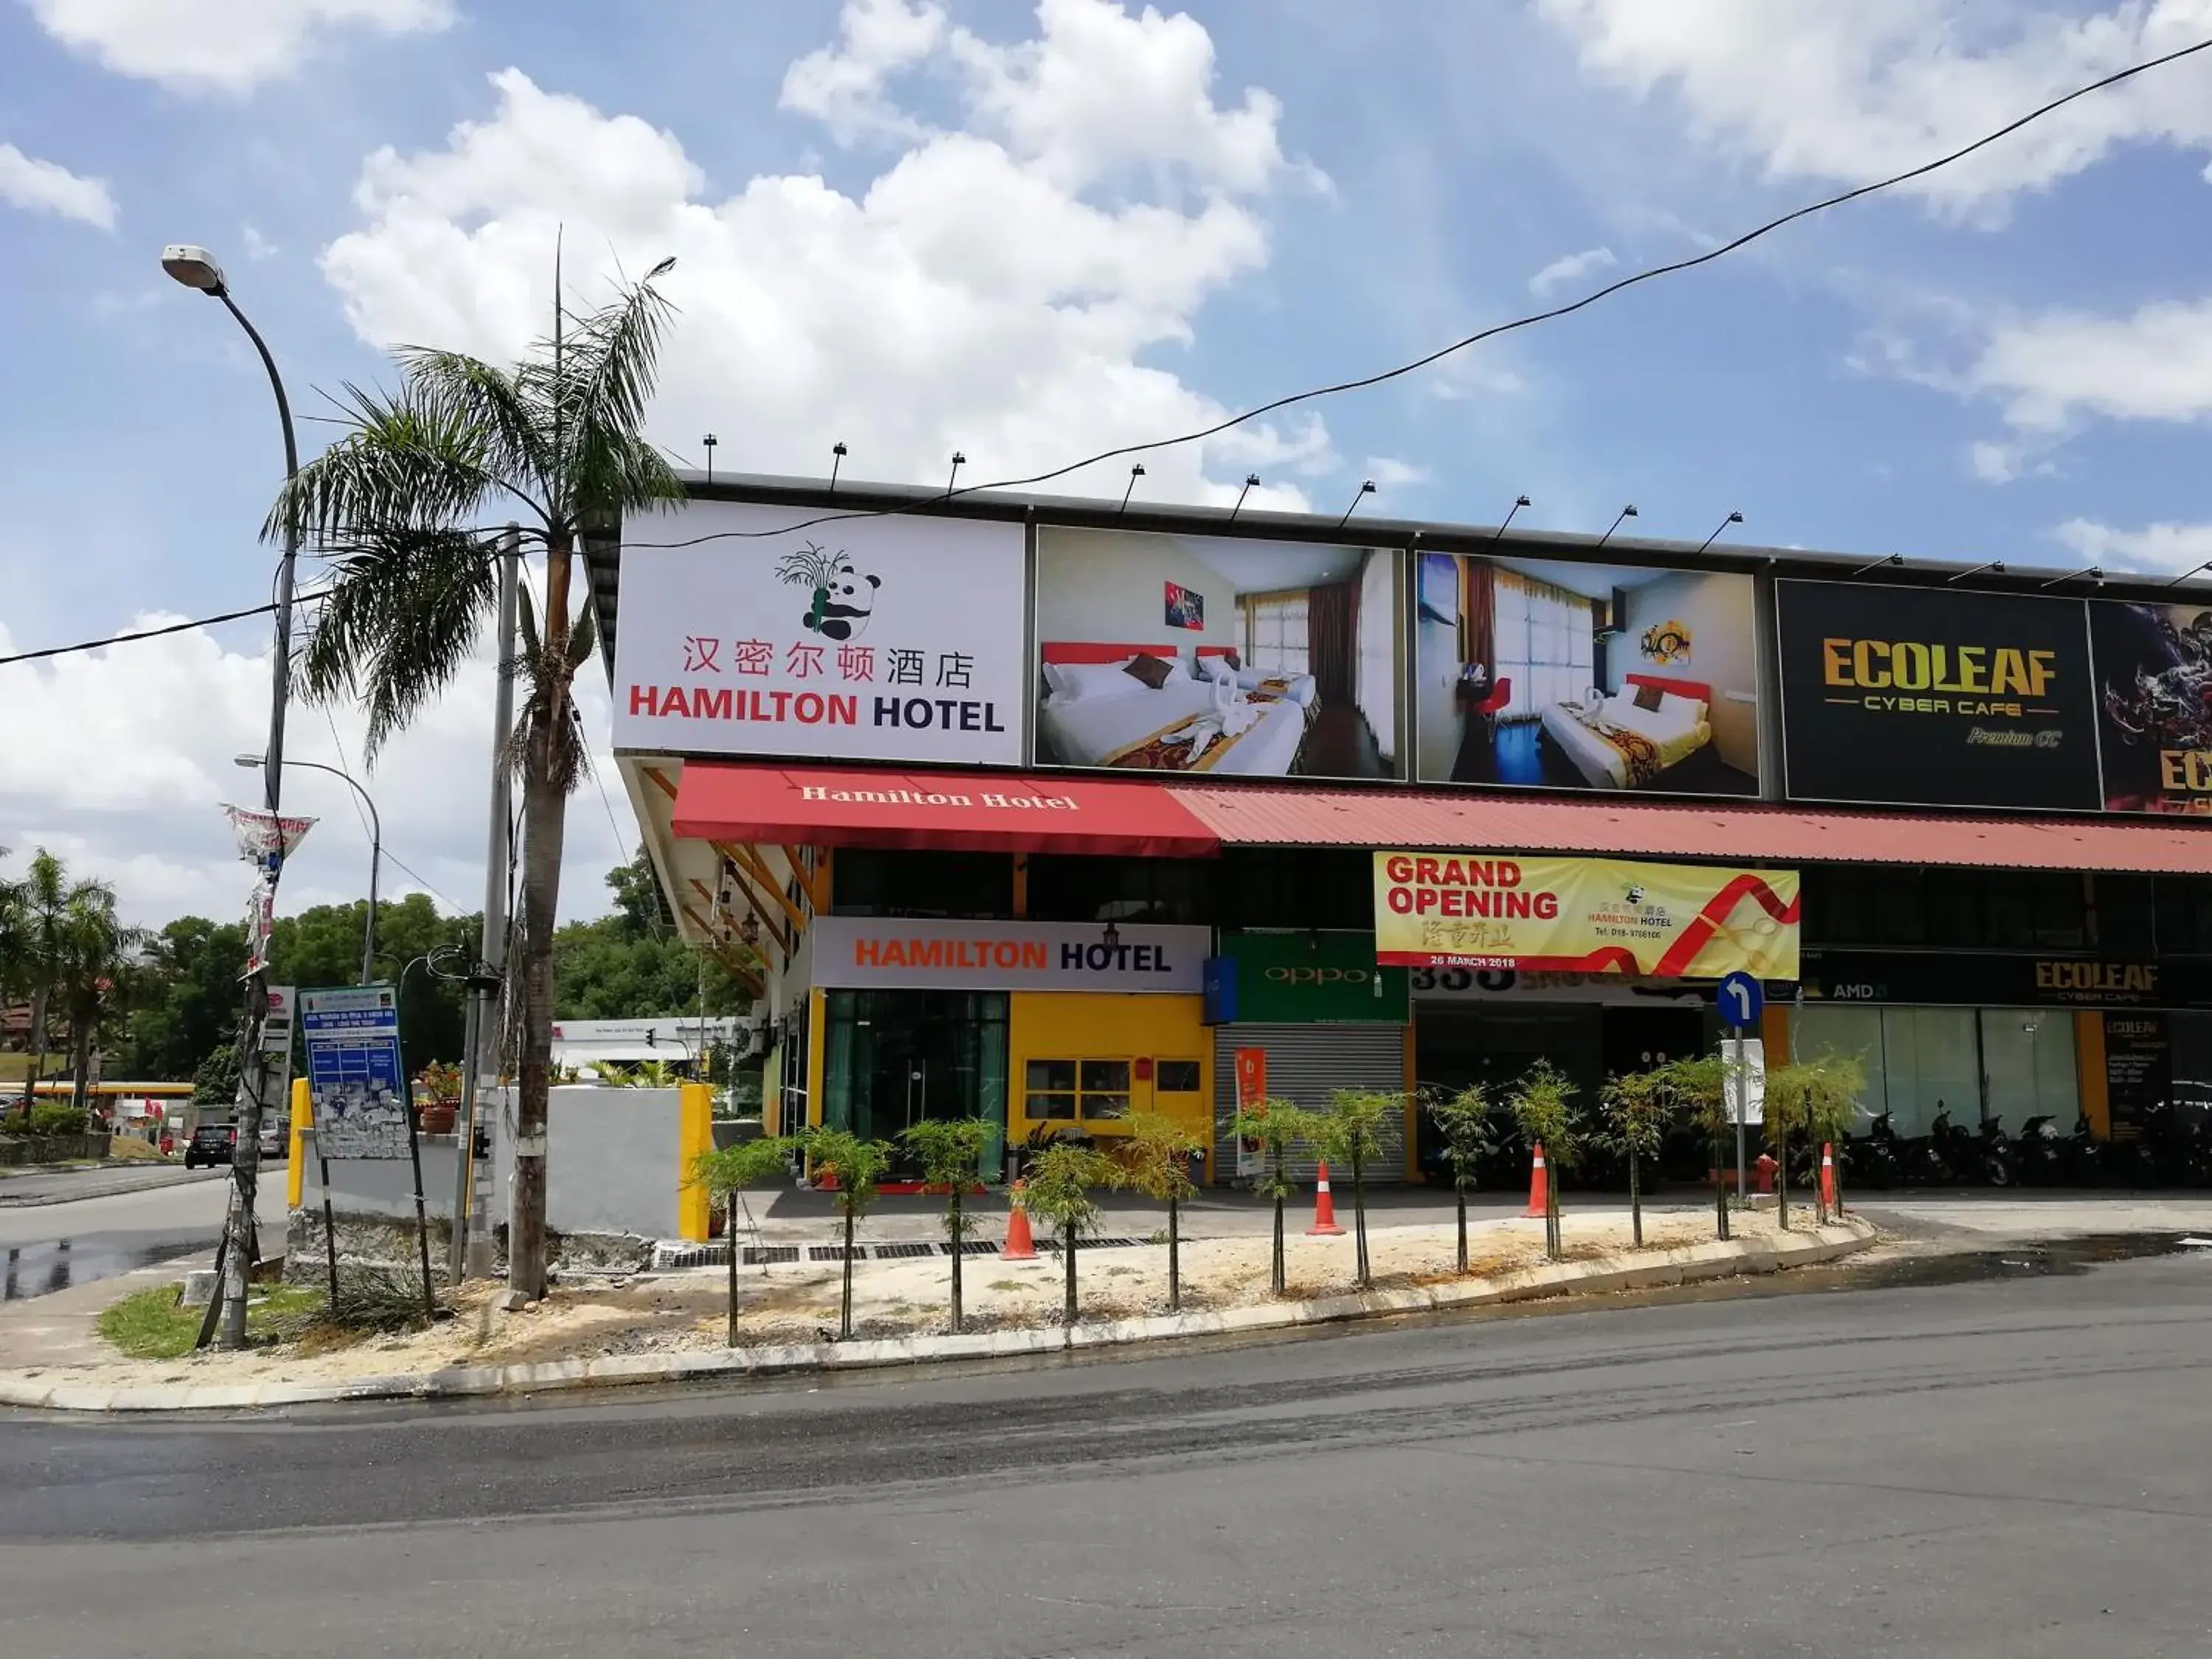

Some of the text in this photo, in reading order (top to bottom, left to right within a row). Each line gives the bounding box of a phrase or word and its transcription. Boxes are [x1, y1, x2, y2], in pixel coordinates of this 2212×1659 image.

[684, 635, 973, 688] 汉密尔顿酒店
[1823, 637, 2056, 696] ECOLEAF
[630, 684, 1006, 732] HAMILTON HOTEL
[1864, 695, 2023, 717] CYBER CAFE
[802, 785, 1080, 811] Hamilton Hotel
[1387, 856, 1522, 888] GRAND
[1388, 887, 1558, 919] OPENING
[1588, 913, 1672, 927] HAMILTON HOTEL
[855, 939, 1172, 973] HAMILTON HOTEL
[1447, 956, 1486, 967] MARCH
[1489, 958, 1515, 967] 2018
[2036, 961, 2158, 990] ECOLEAF
[1834, 984, 1874, 998] AMD
[2057, 992, 2102, 1001] CYBER
